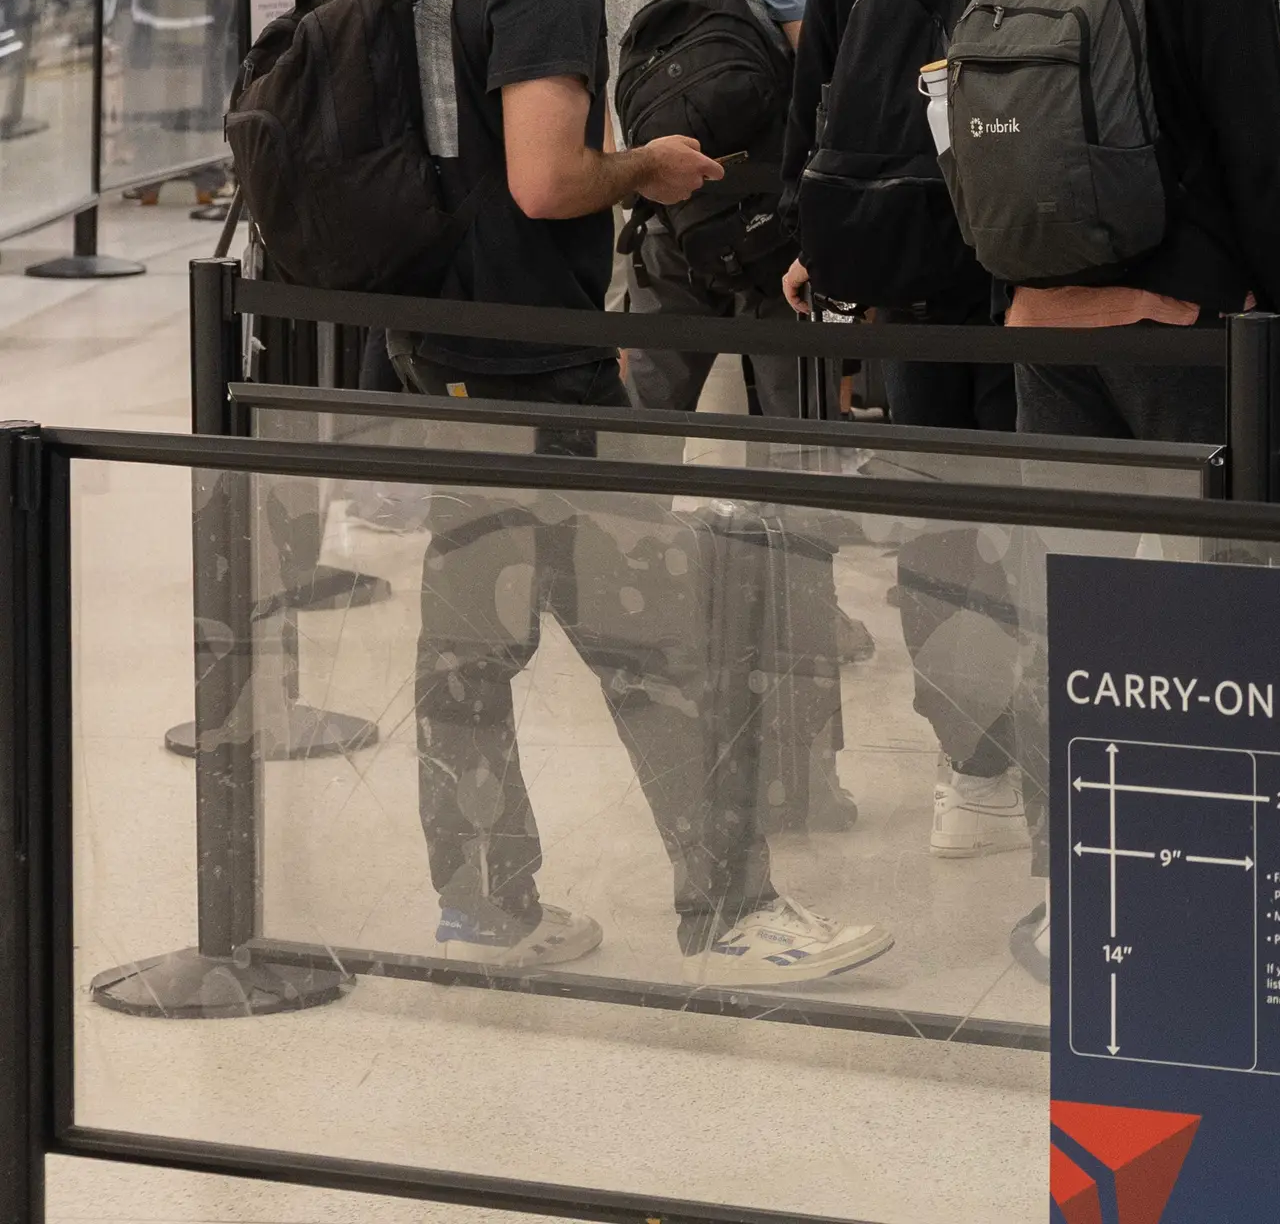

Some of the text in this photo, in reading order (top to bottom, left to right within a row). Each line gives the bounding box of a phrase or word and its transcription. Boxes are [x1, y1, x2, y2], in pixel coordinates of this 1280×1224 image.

[985, 117, 1021, 133] rubrik
[1066, 669, 1273, 719] CARRY-ON
[1266, 963, 1274, 975] If
